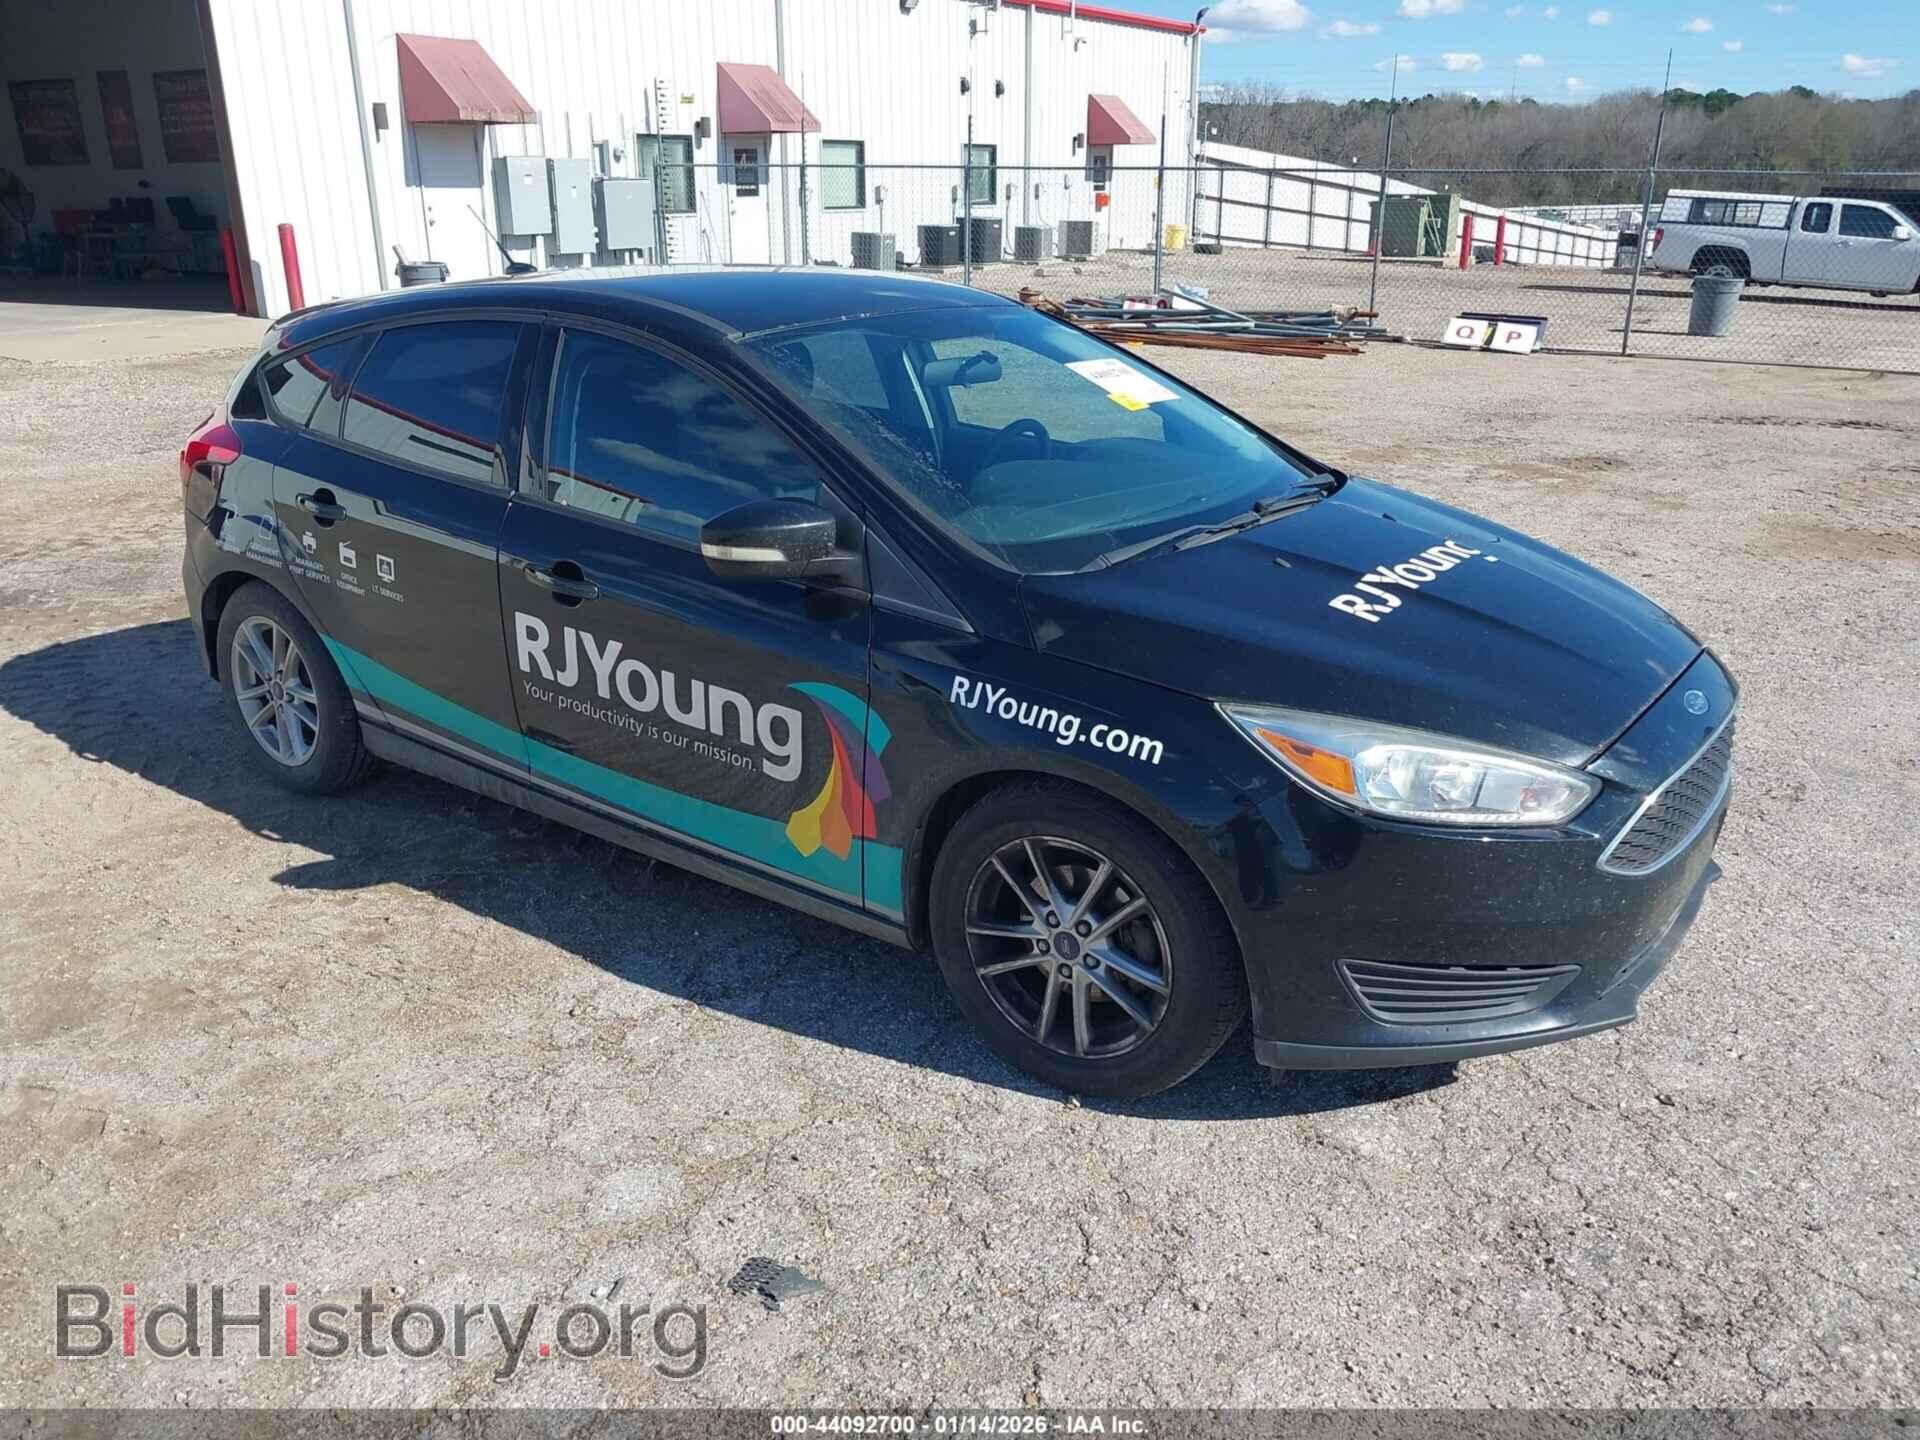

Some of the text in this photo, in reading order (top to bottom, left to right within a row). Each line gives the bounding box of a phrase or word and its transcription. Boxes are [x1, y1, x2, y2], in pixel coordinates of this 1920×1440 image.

[1505, 330, 1522, 344] P
[514, 611, 802, 782] RJYoung
[523, 680, 757, 772] Your productivity is our mission.
[950, 675, 1164, 765] RJYoung.com
